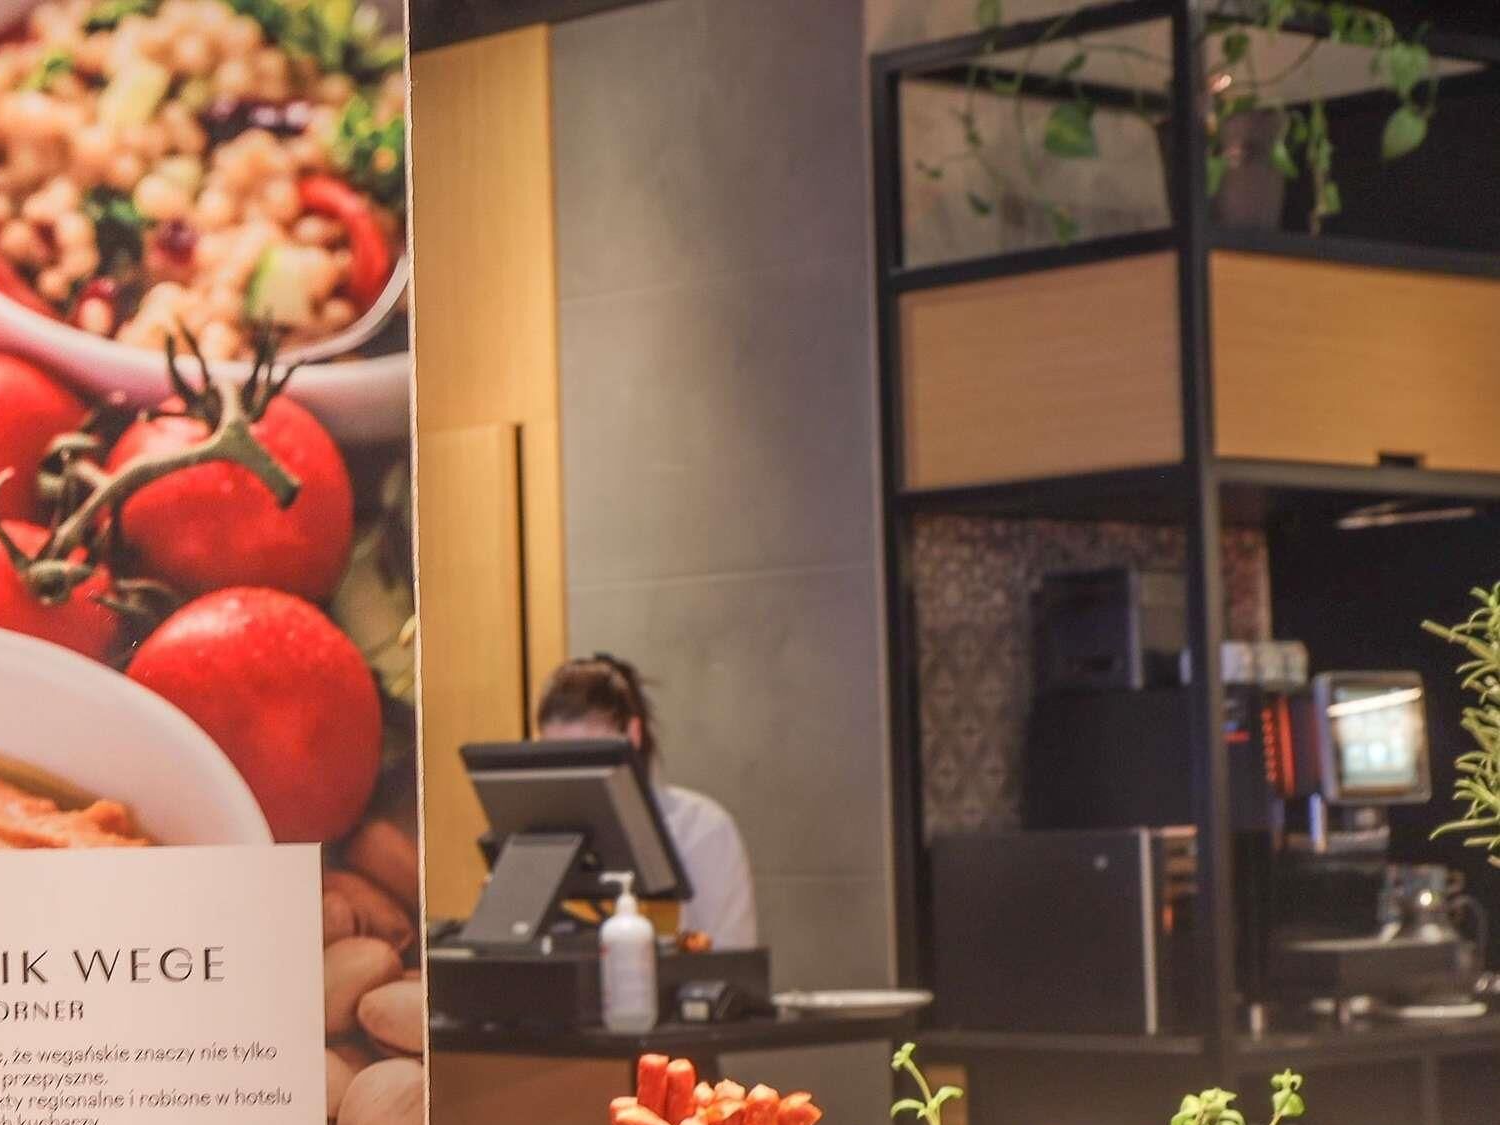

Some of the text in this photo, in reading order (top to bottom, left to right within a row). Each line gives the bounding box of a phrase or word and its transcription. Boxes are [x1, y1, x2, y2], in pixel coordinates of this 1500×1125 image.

[72, 946, 226, 984] WEGE
[38, 1043, 130, 1067] wegańskie
[134, 1047, 196, 1065] znaczy
[200, 1042, 229, 1062] nie
[233, 1040, 278, 1064] tylko
[28, 1089, 125, 1113] regionalne
[140, 1087, 212, 1108] robione
[216, 1093, 230, 1106] w
[235, 1086, 293, 1106] hotelu
